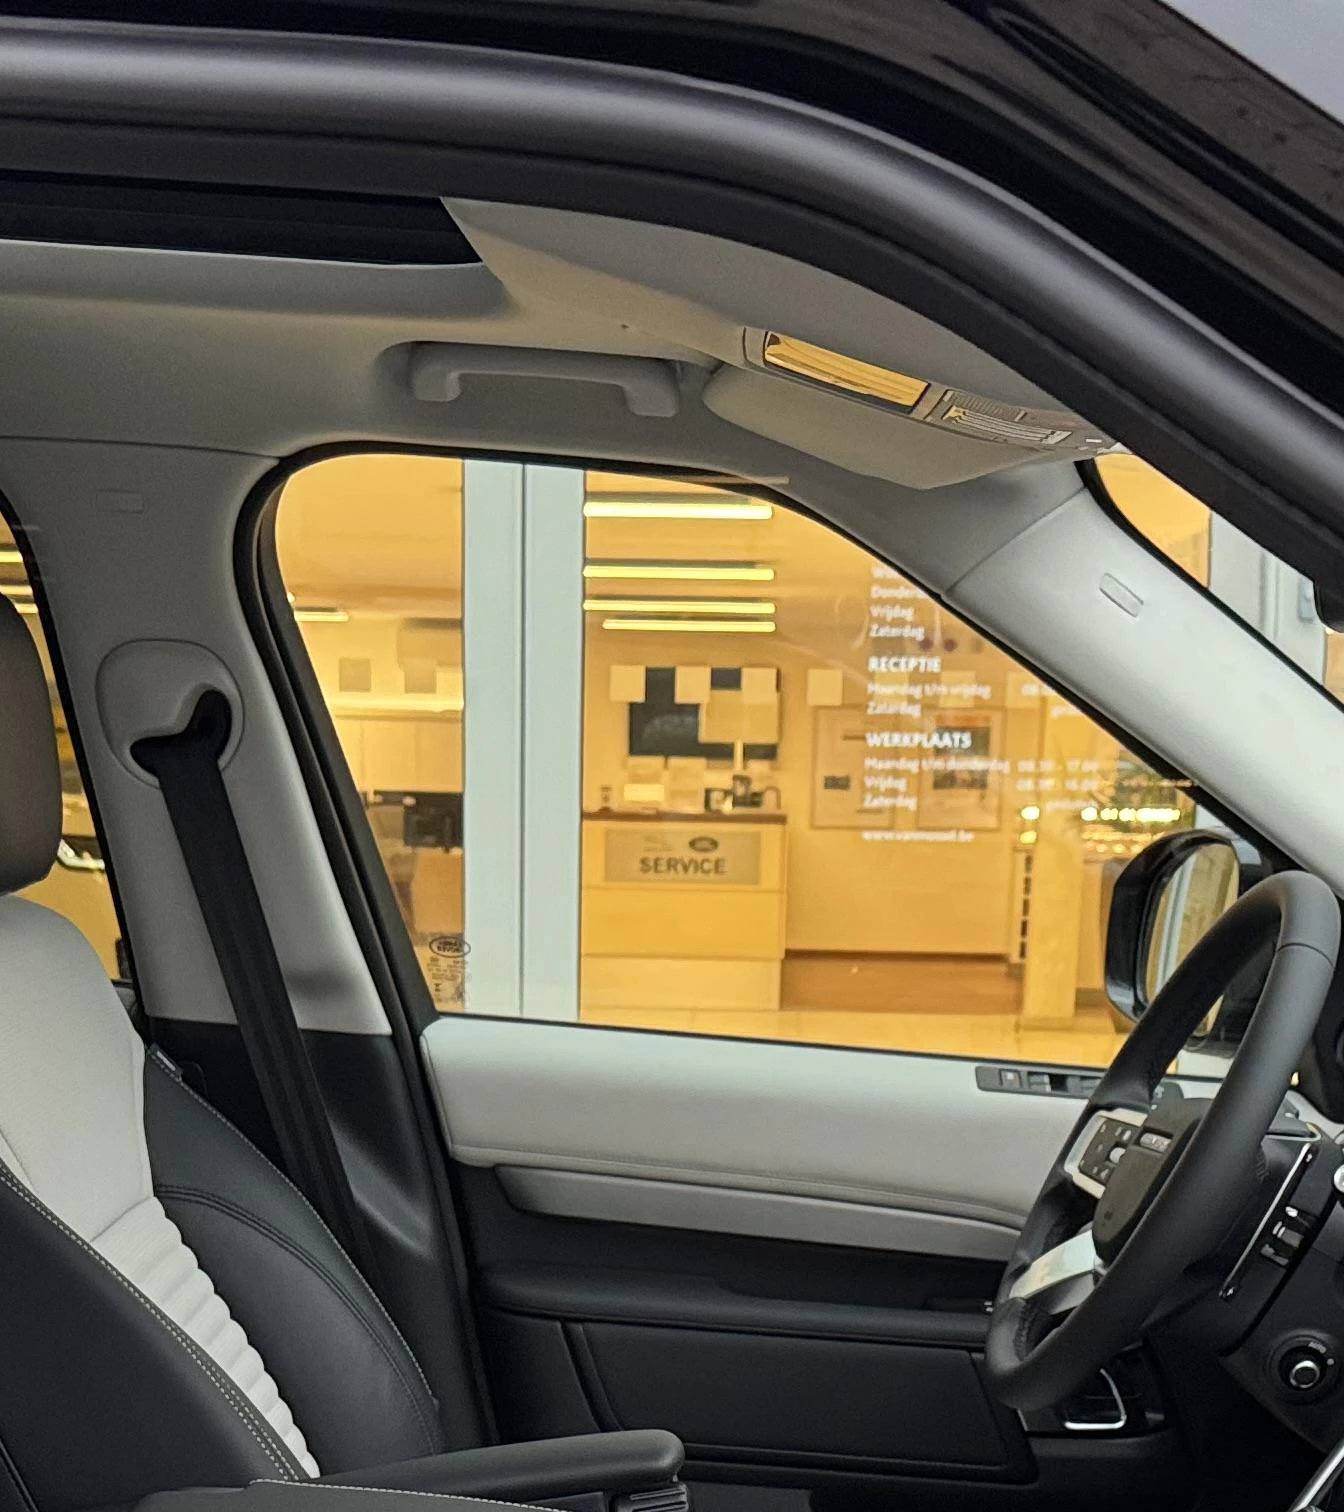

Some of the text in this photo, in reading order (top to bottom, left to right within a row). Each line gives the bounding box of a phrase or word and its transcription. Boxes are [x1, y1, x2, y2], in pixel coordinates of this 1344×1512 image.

[869, 624, 926, 641] Zaterdag
[868, 656, 942, 673] RECEPTIE
[865, 731, 973, 750] WERKPLAATS
[639, 857, 729, 874] SERVICE
